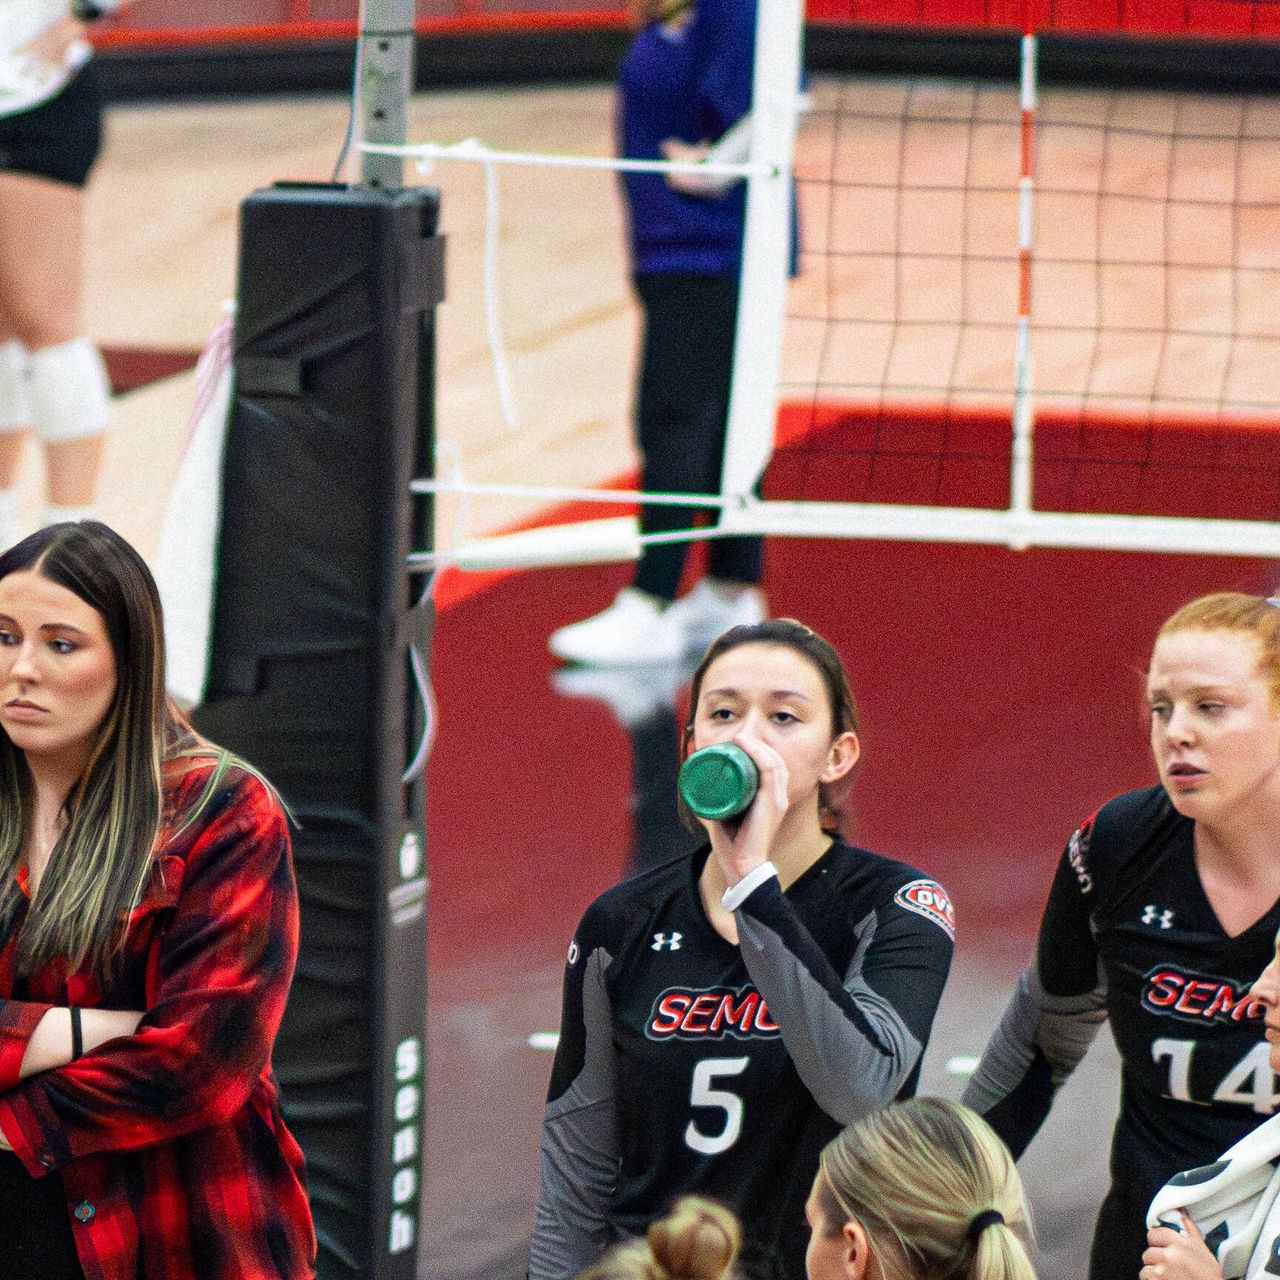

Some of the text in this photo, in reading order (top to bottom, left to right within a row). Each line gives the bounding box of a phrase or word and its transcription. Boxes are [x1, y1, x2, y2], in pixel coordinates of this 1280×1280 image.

[685, 1055, 750, 1155] 5
[1151, 1037, 1280, 1115] 14
[388, 1036, 421, 1255] senoh
